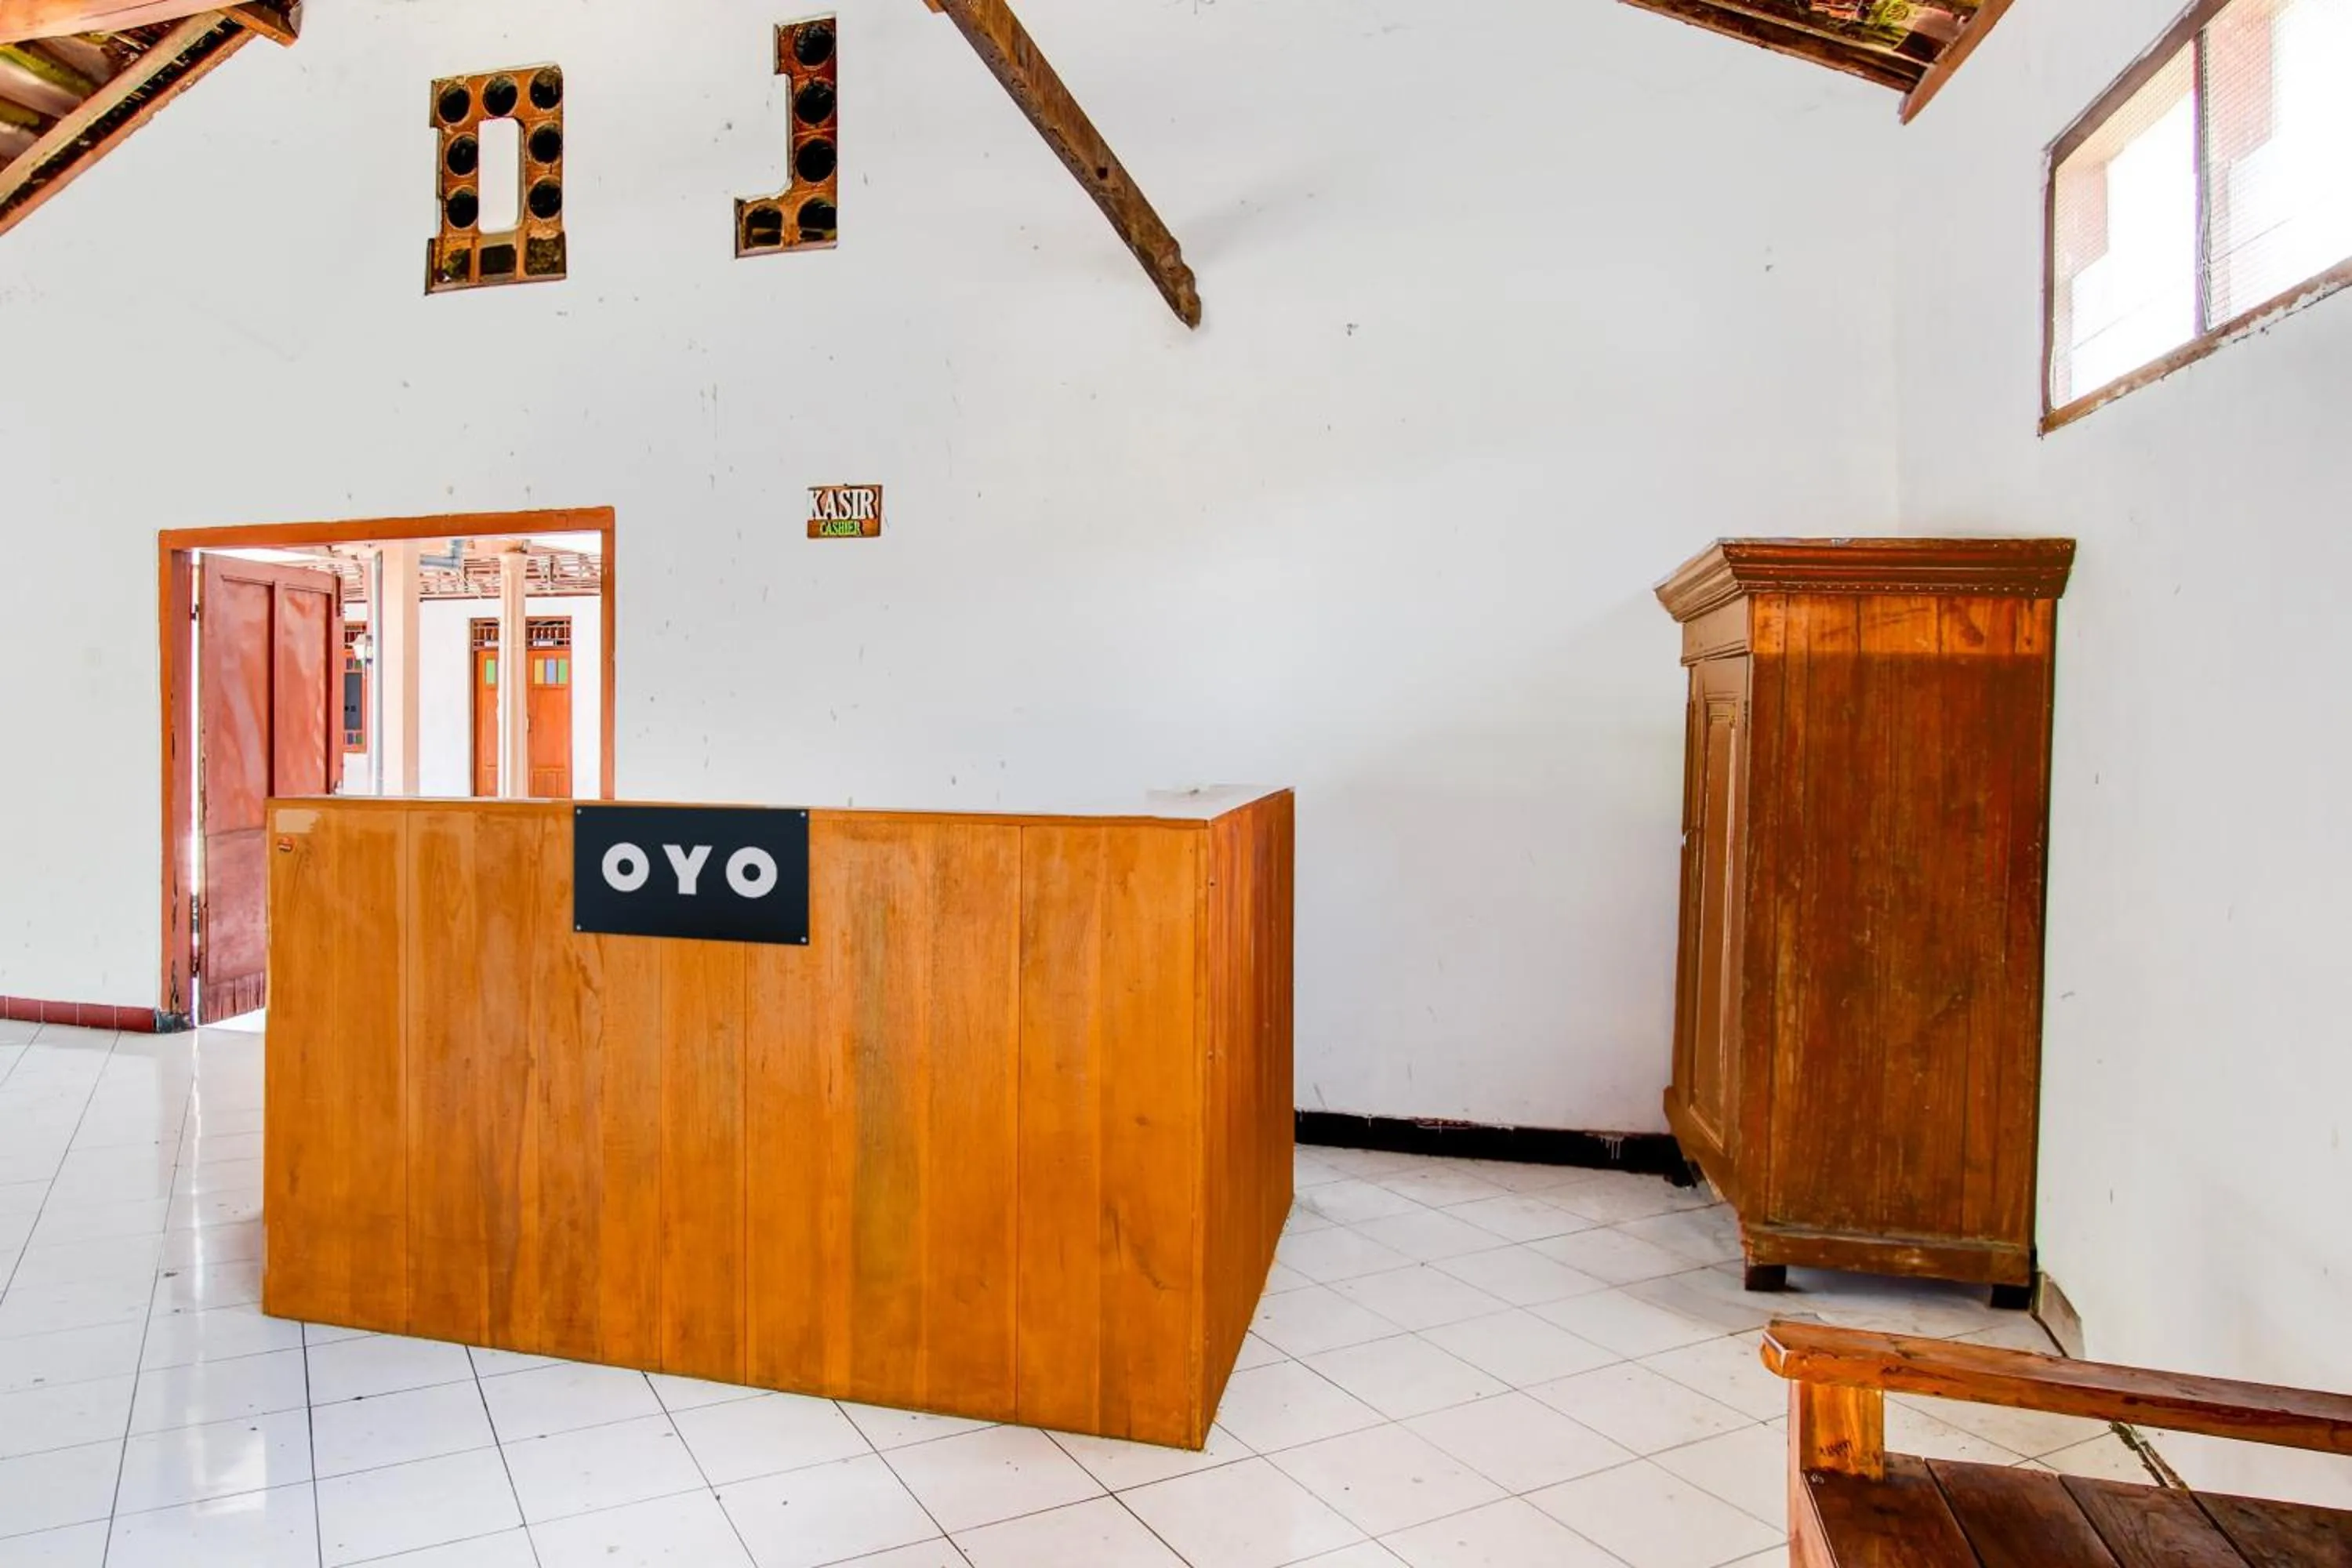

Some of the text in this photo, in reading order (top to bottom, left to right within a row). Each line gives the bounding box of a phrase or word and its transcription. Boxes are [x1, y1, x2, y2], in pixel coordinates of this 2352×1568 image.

[808, 488, 877, 520] KASIR
[819, 521, 862, 536] CASHIER
[601, 841, 778, 899] OYO
